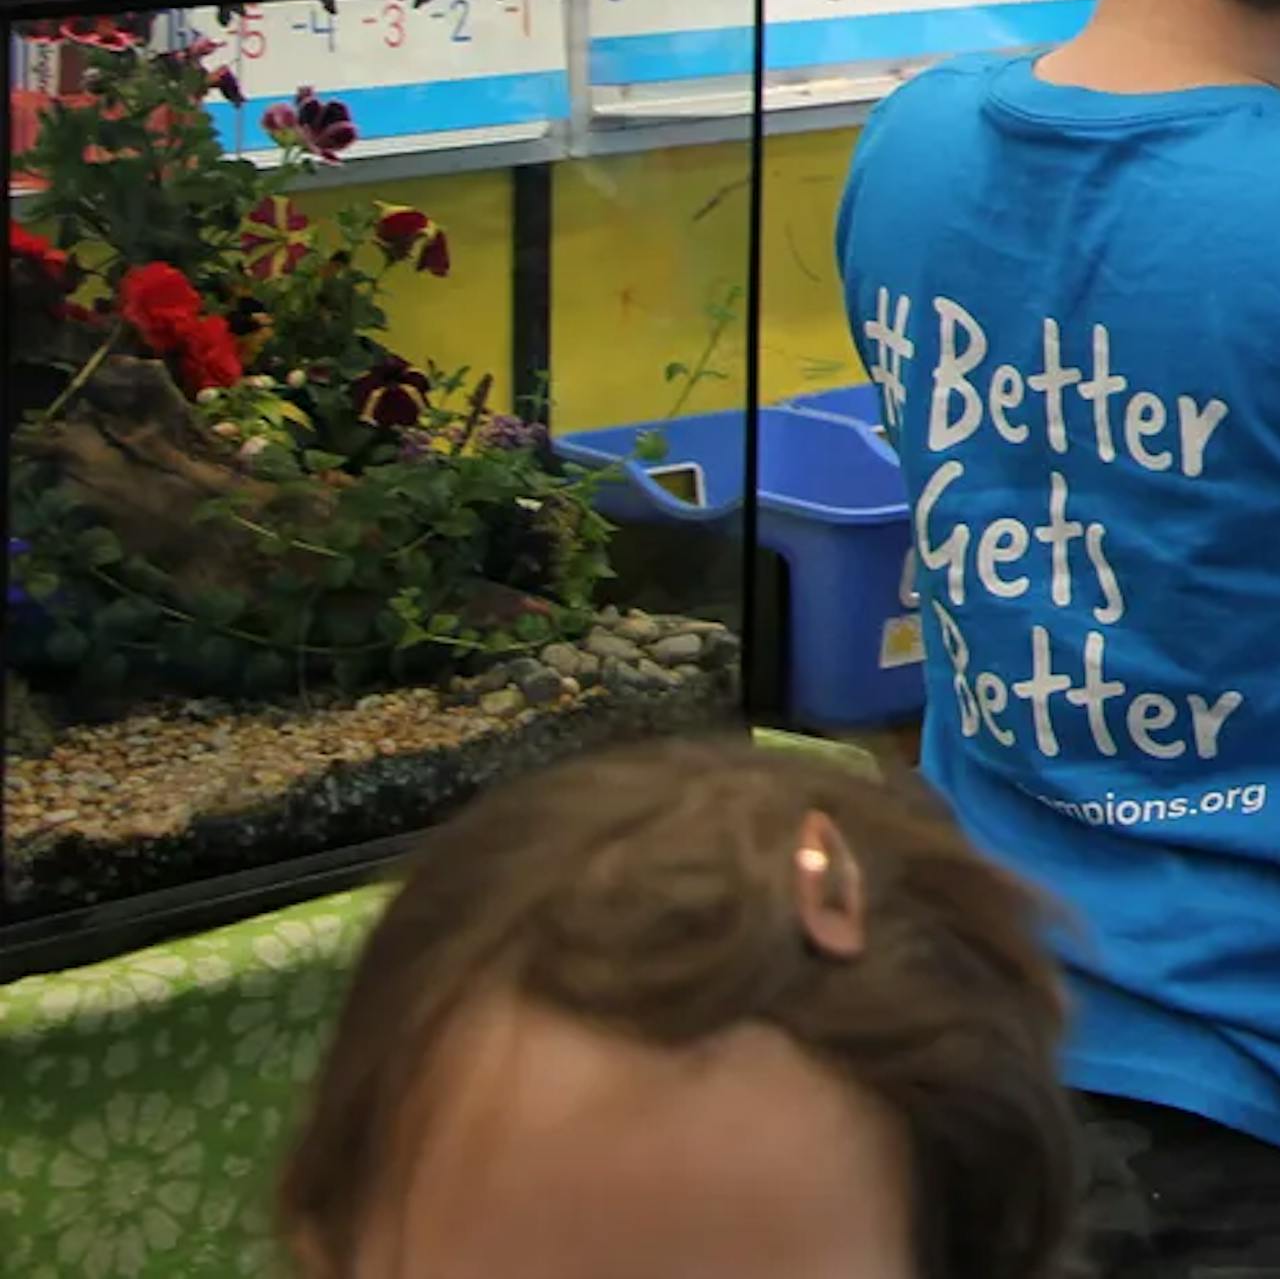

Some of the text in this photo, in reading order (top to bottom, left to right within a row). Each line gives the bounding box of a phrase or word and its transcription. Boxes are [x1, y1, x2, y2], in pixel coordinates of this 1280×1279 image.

[361, 2, 406, 48] -3
[864, 285, 1231, 478] #Better
[912, 459, 1125, 624] Gets
[931, 597, 1245, 760] Better
[1046, 783, 1267, 827] mpions.org
